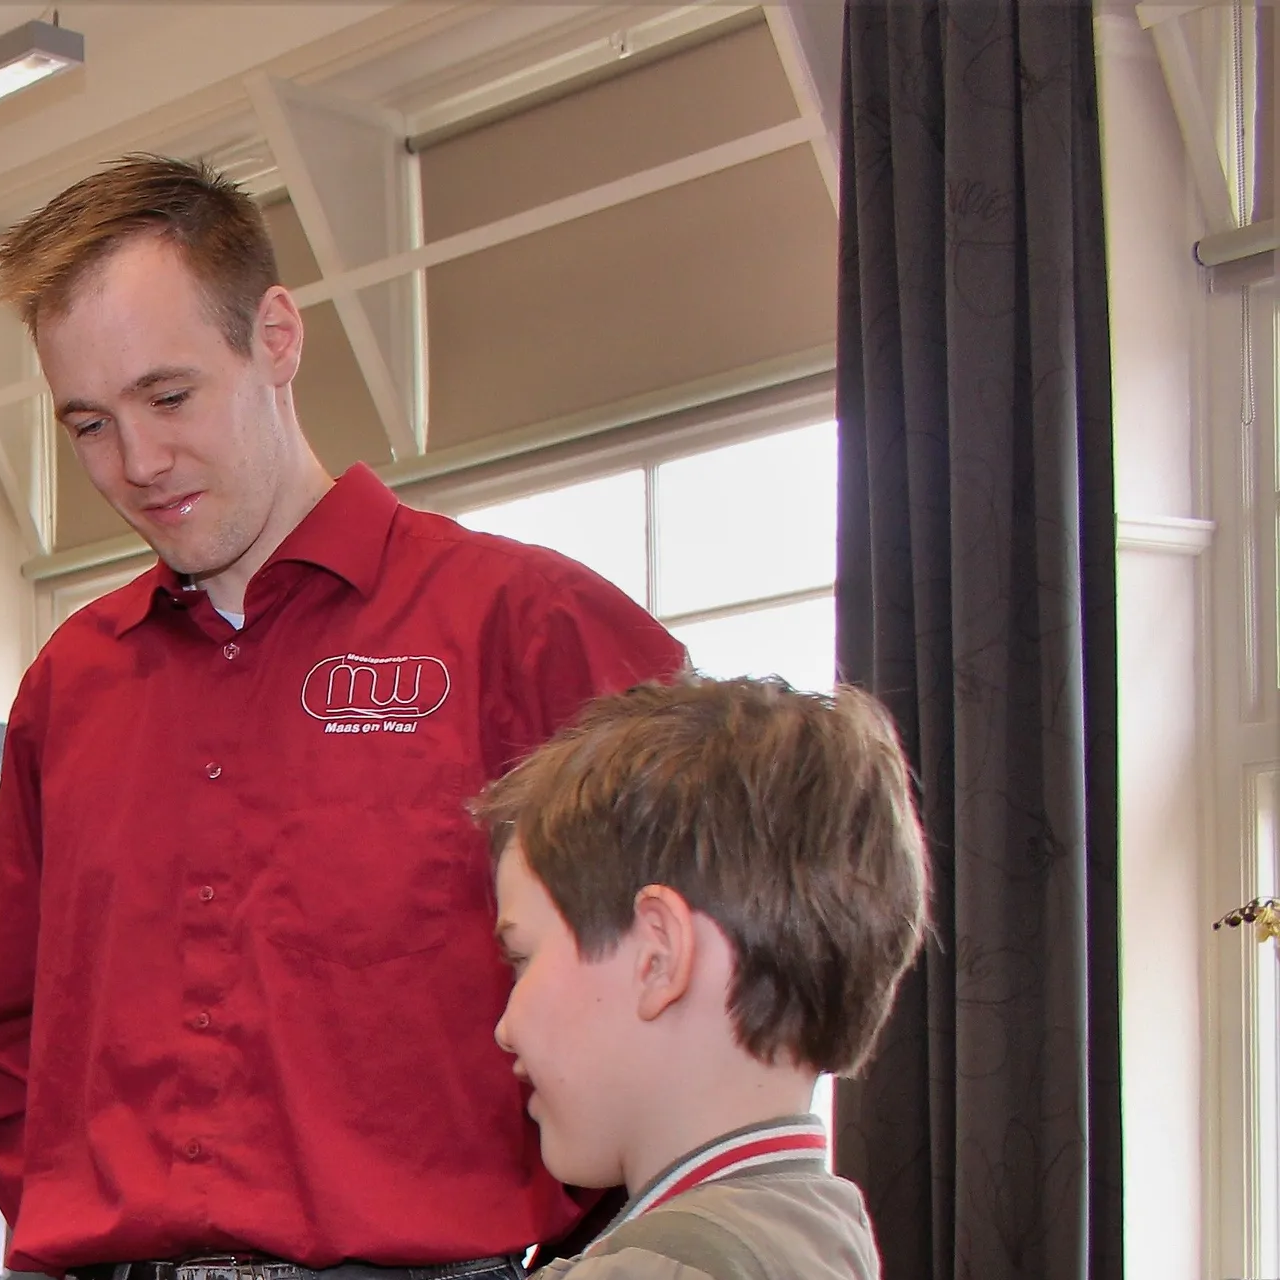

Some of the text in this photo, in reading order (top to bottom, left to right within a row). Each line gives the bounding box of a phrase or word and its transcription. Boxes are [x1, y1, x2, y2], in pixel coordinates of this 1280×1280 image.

[324, 721, 418, 733] Maas en Waal
